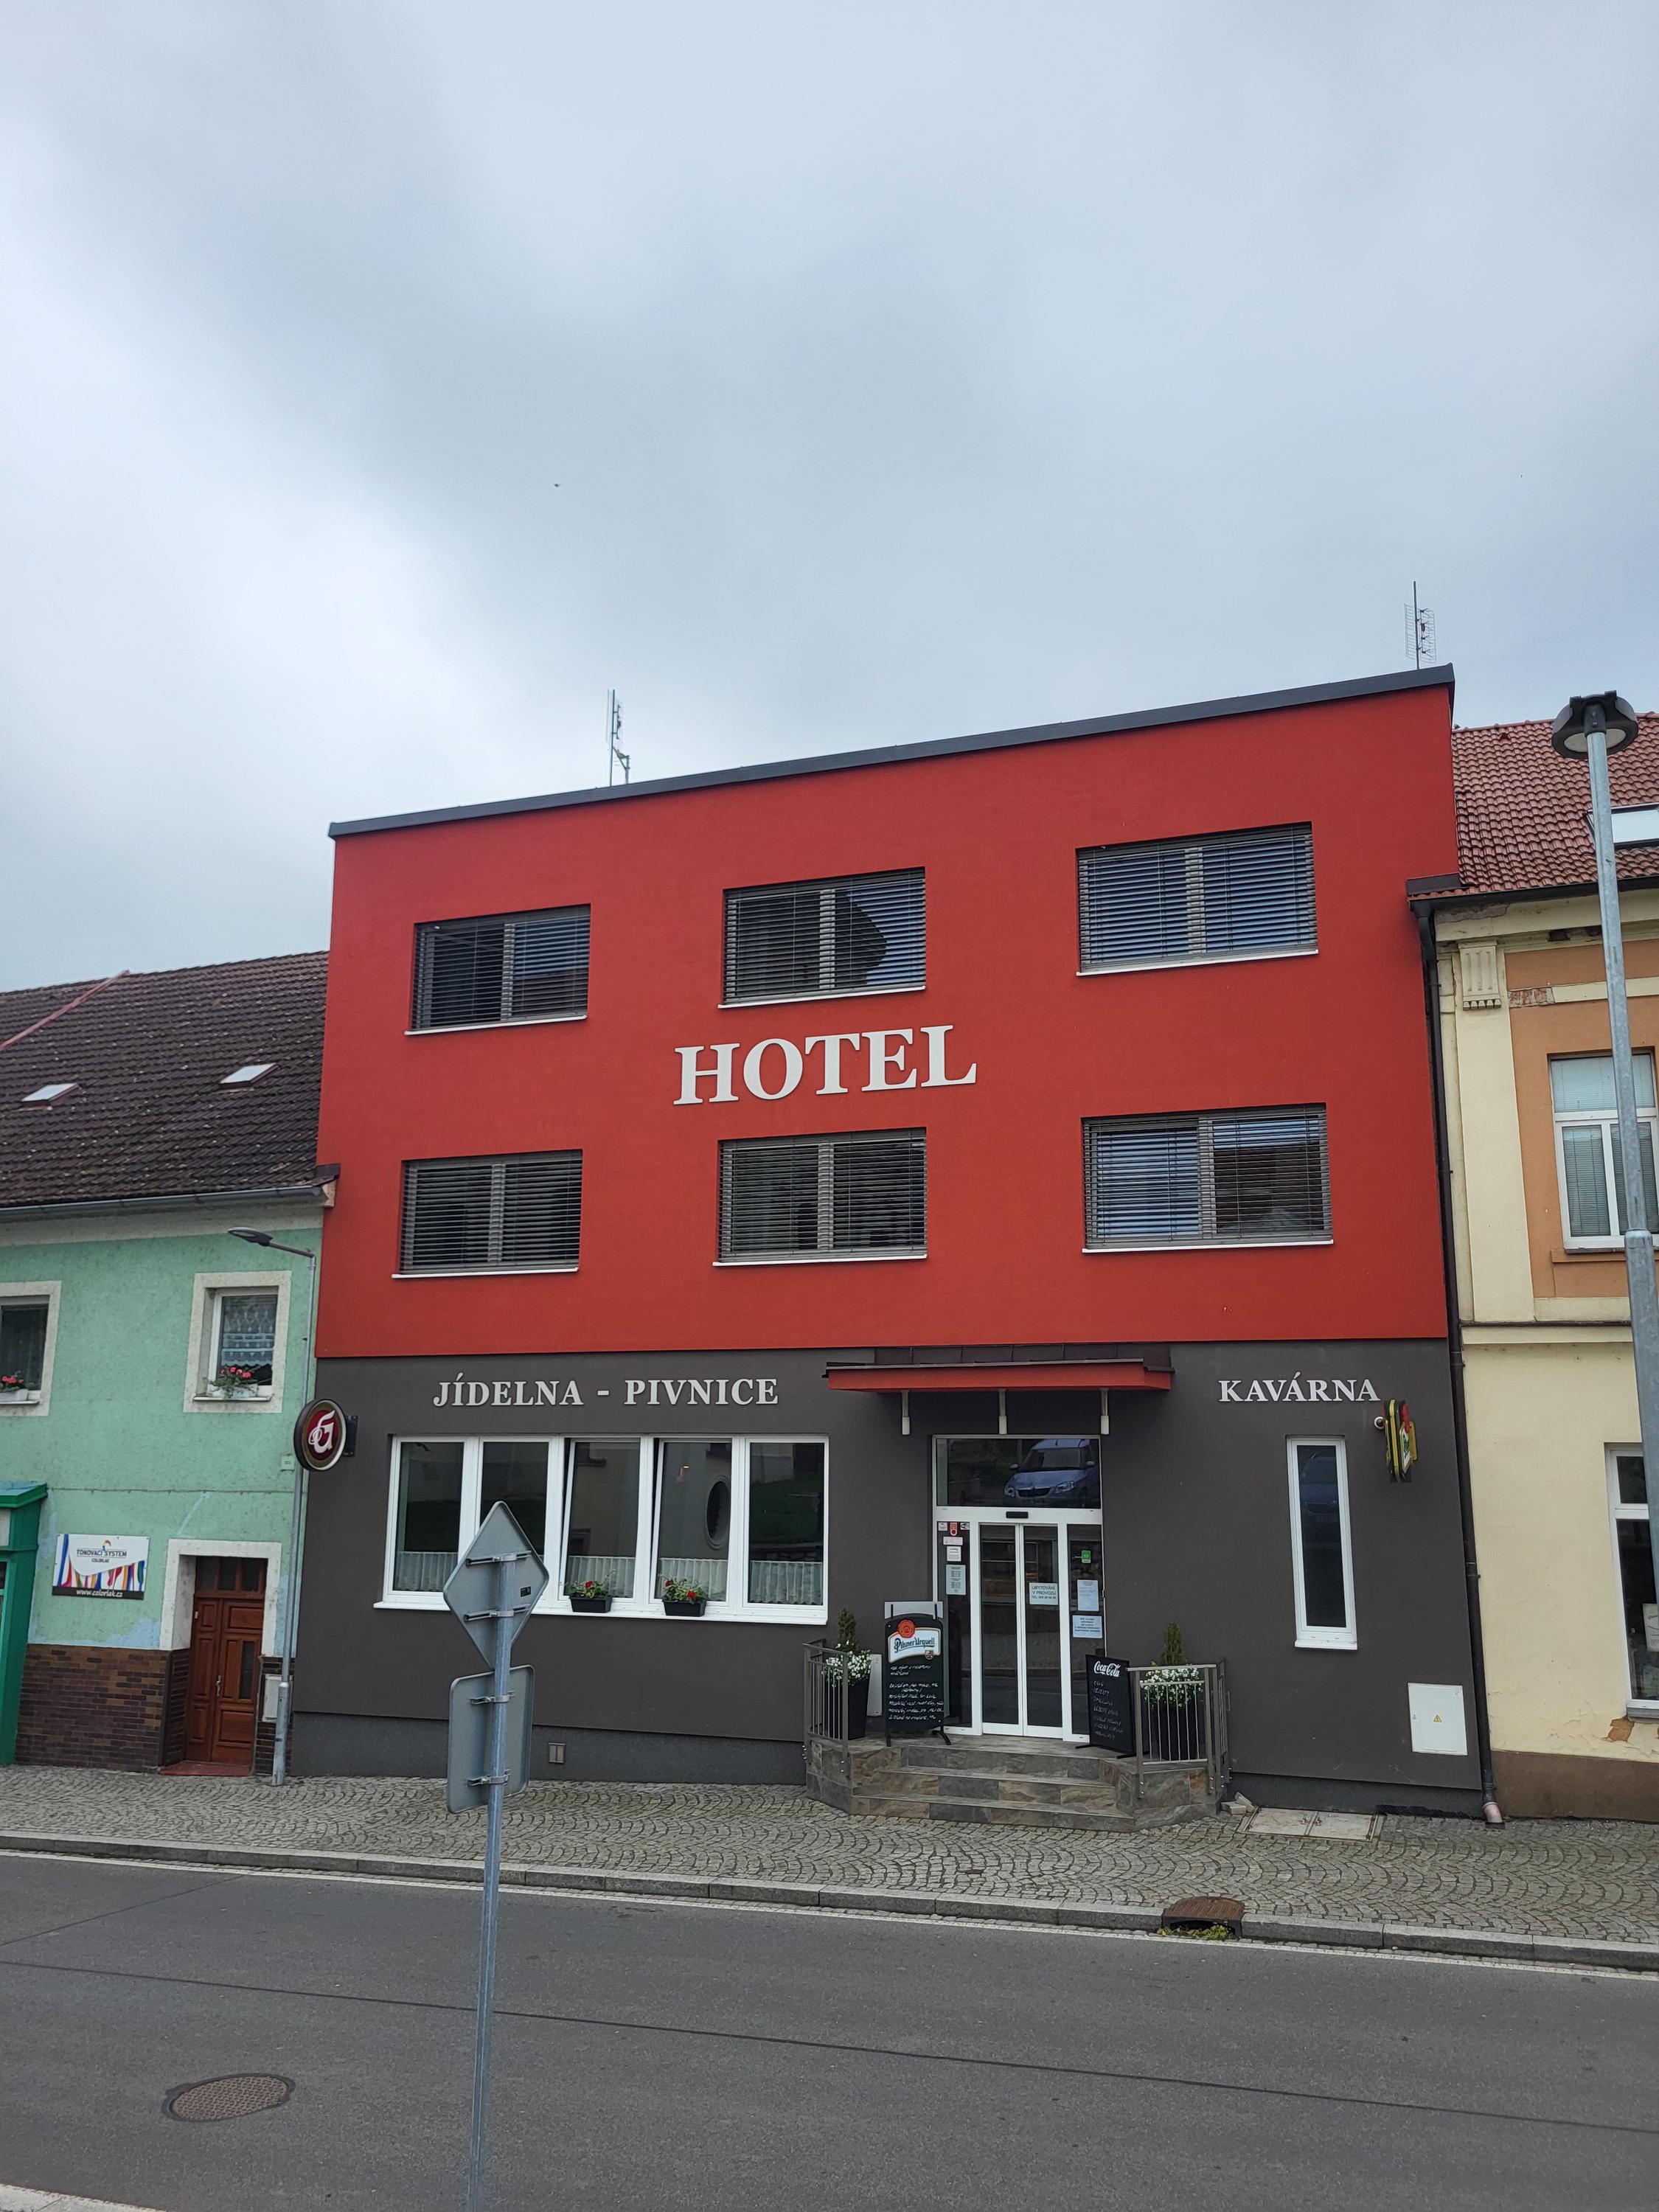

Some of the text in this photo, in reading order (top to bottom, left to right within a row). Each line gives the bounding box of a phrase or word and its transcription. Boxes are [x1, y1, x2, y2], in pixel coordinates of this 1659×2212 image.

[672, 1024, 978, 1105] HOTEL
[433, 1371, 585, 1407] JÍDELNA
[623, 1377, 779, 1406] PIVNICE
[1217, 1371, 1382, 1402] KAVÁRNA
[894, 1637, 935, 1653] Pilsner Urquell
